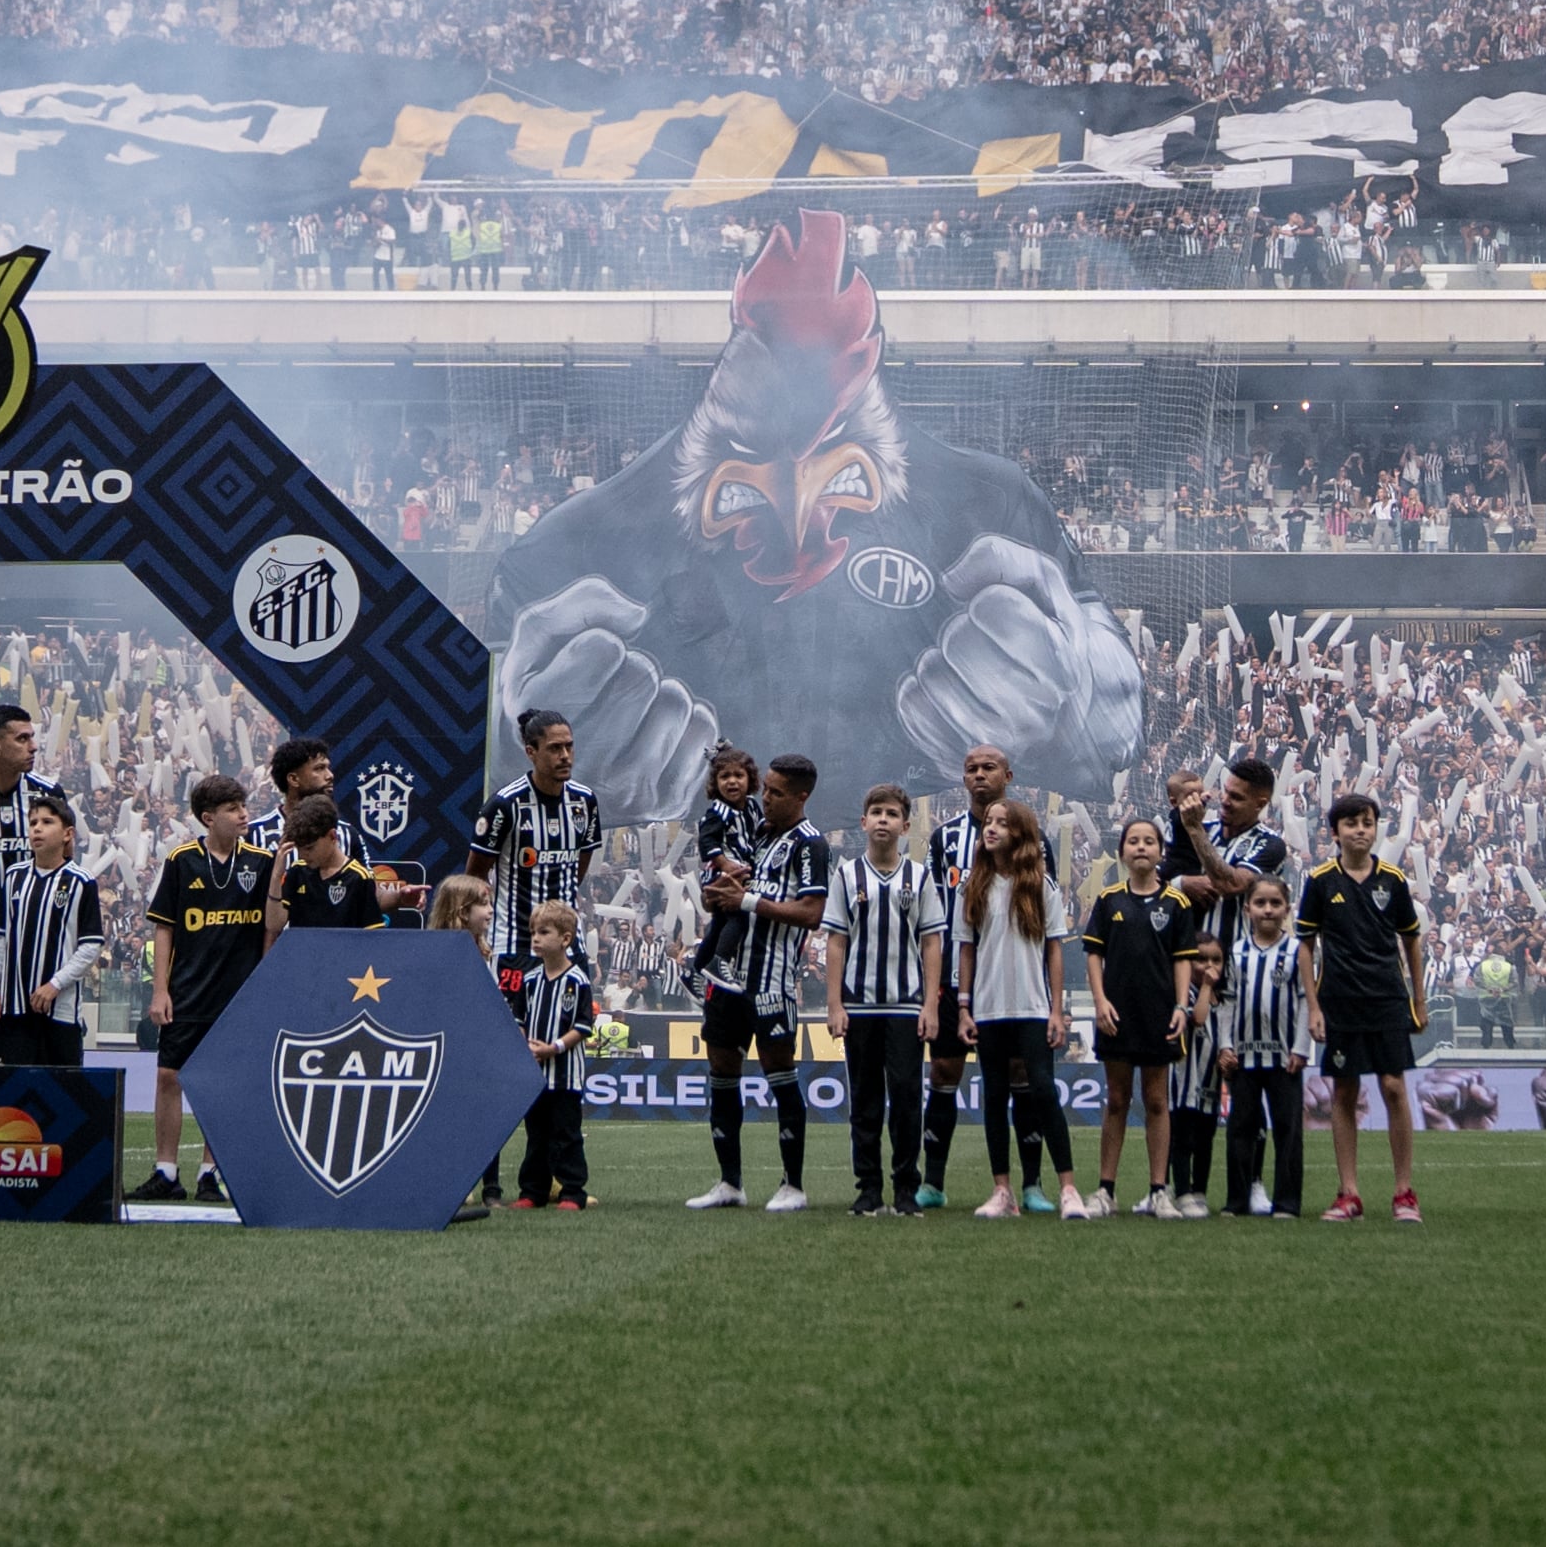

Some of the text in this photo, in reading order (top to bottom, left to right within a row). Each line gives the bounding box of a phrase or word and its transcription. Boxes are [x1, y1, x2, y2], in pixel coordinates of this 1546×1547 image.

[853, 553, 929, 605] CAM
[205, 909, 262, 926] BETANO
[499, 968, 523, 992] 28
[299, 1049, 416, 1076] CAM
